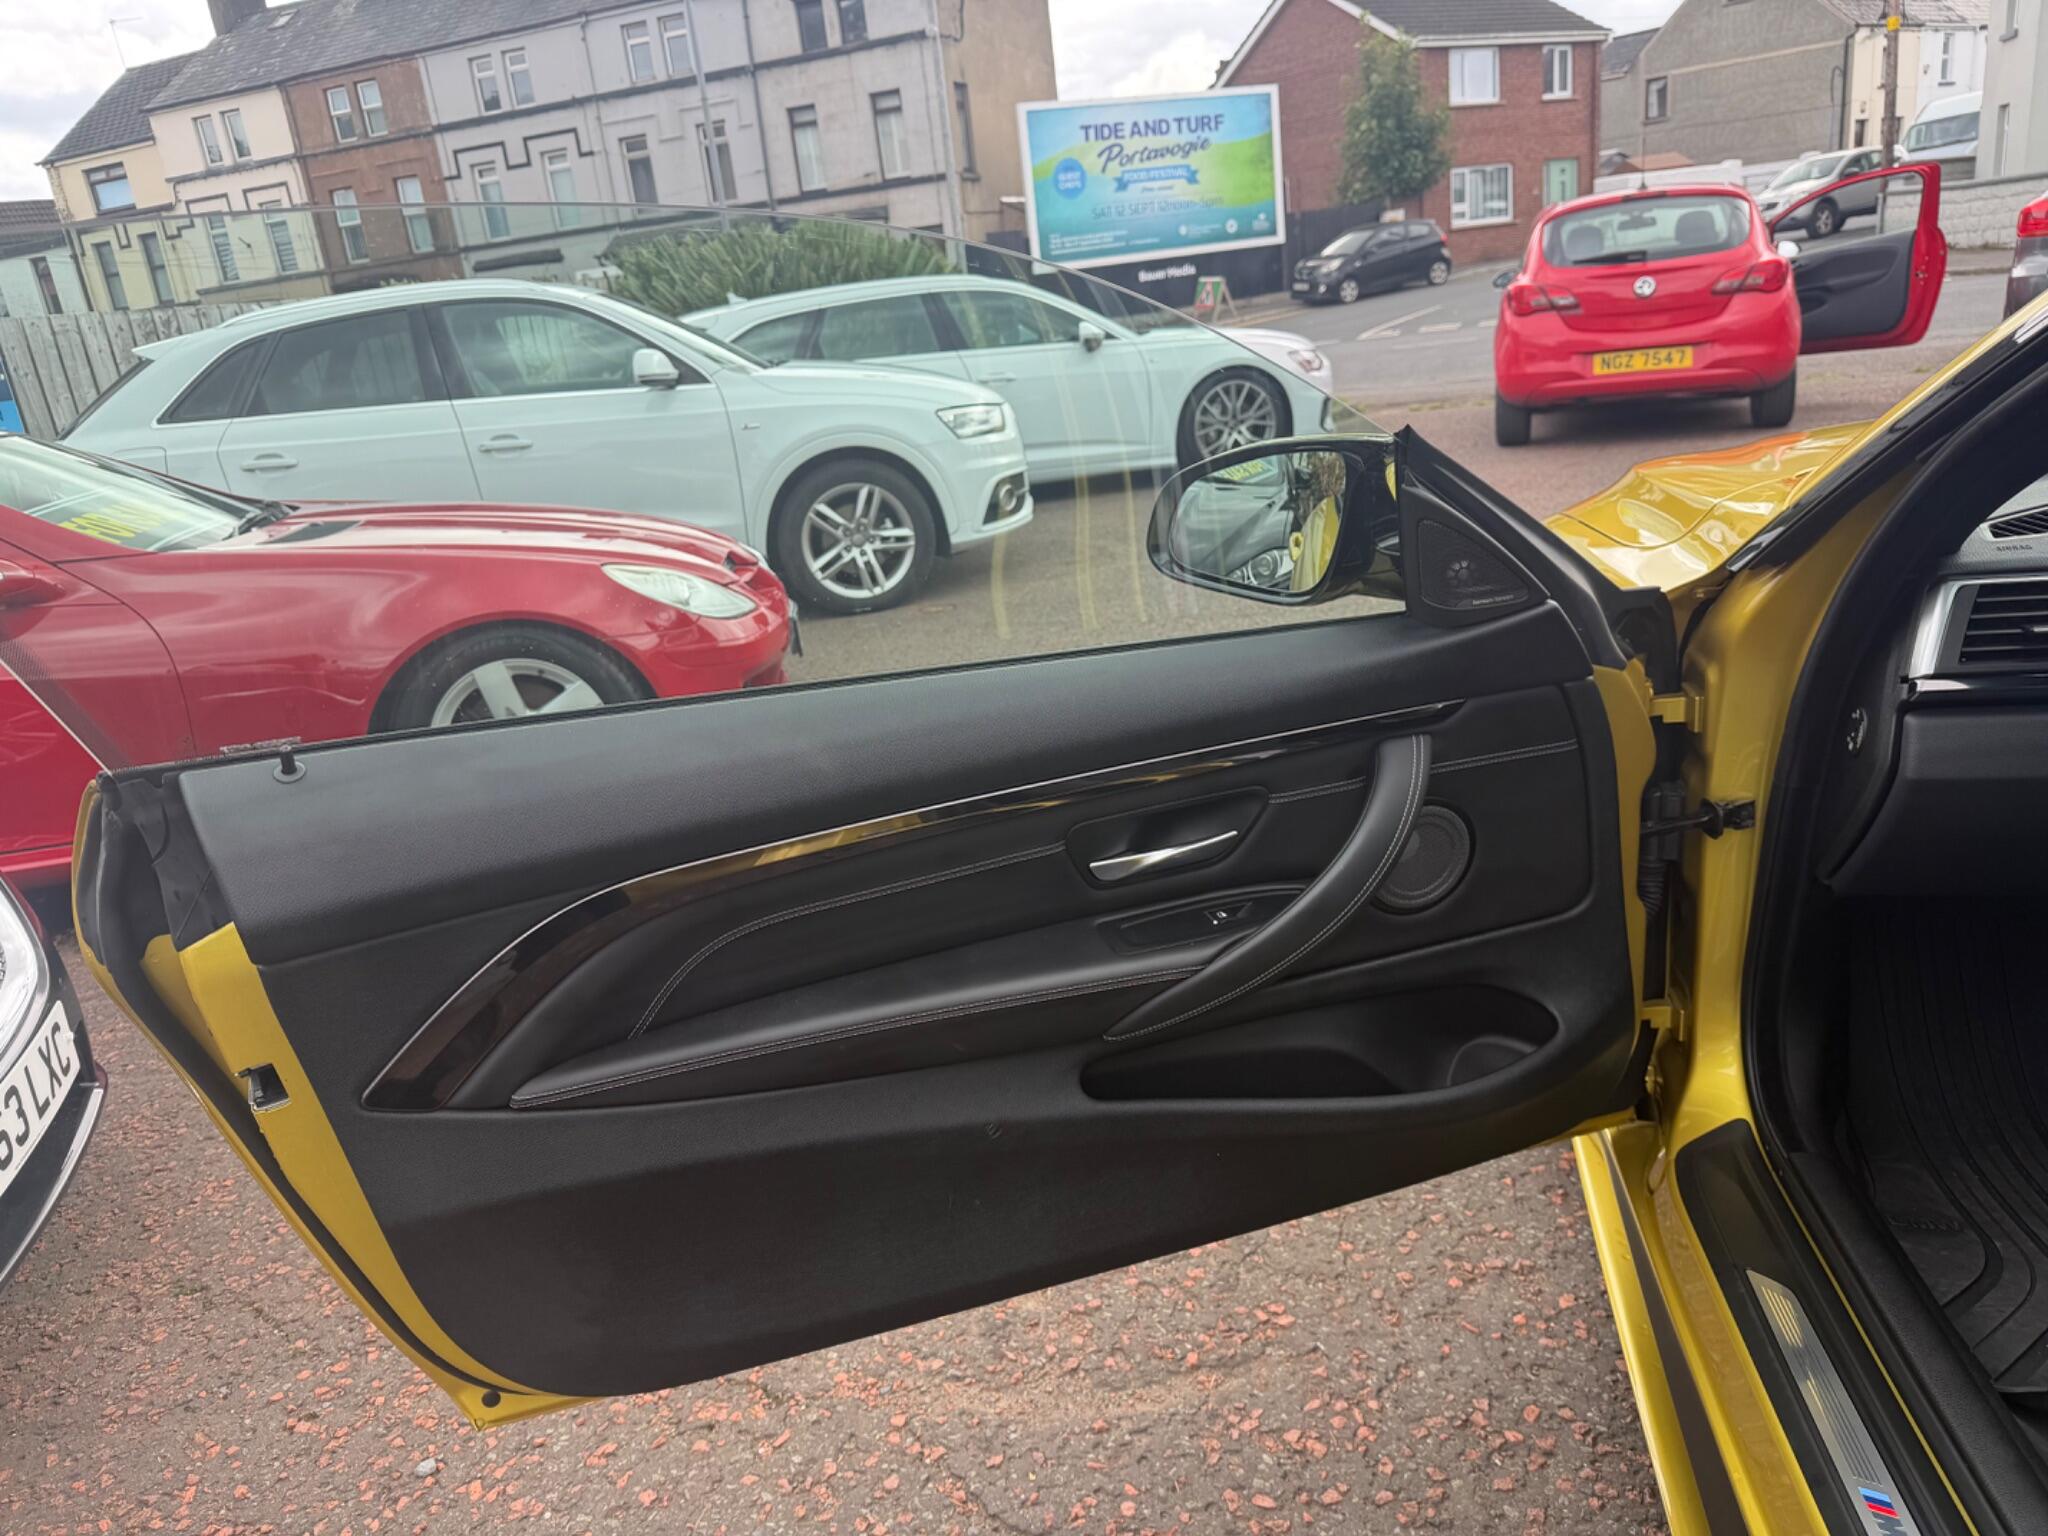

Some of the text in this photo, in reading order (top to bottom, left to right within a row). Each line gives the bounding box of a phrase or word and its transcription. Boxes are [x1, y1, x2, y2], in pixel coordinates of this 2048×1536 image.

[1080, 114, 1225, 142] TIDE AND TURF
[1600, 348, 1687, 371] NGZ 7547
[24, 1021, 71, 1120] LXC
